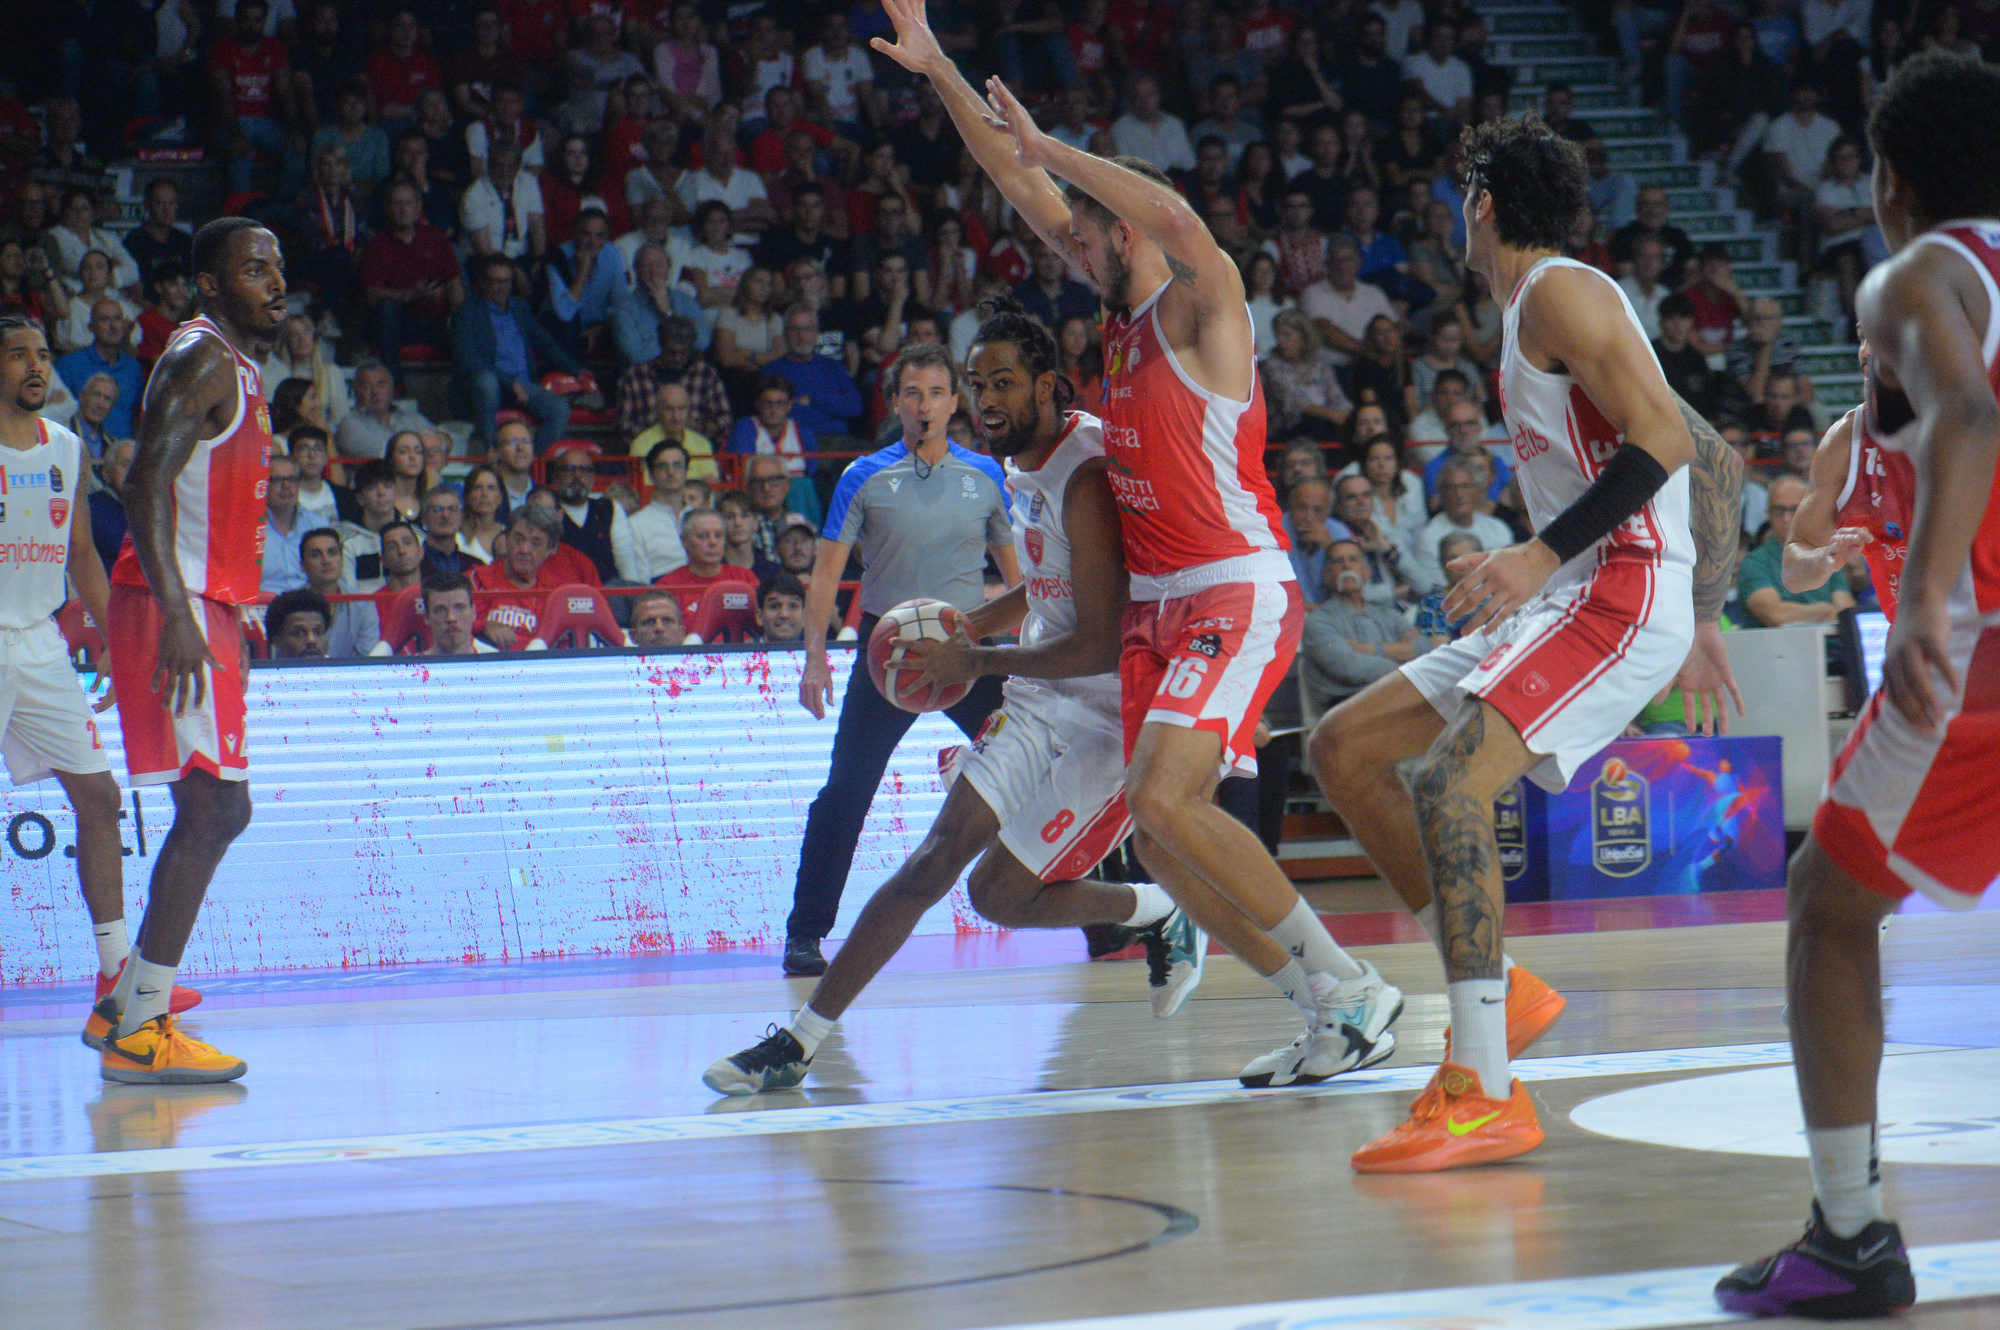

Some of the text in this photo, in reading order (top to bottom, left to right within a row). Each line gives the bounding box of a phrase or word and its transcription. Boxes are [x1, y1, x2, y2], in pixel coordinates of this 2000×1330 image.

[1156, 655, 1209, 699] 16
[1040, 808, 1075, 844] 8
[1600, 806, 1643, 827] LBA
